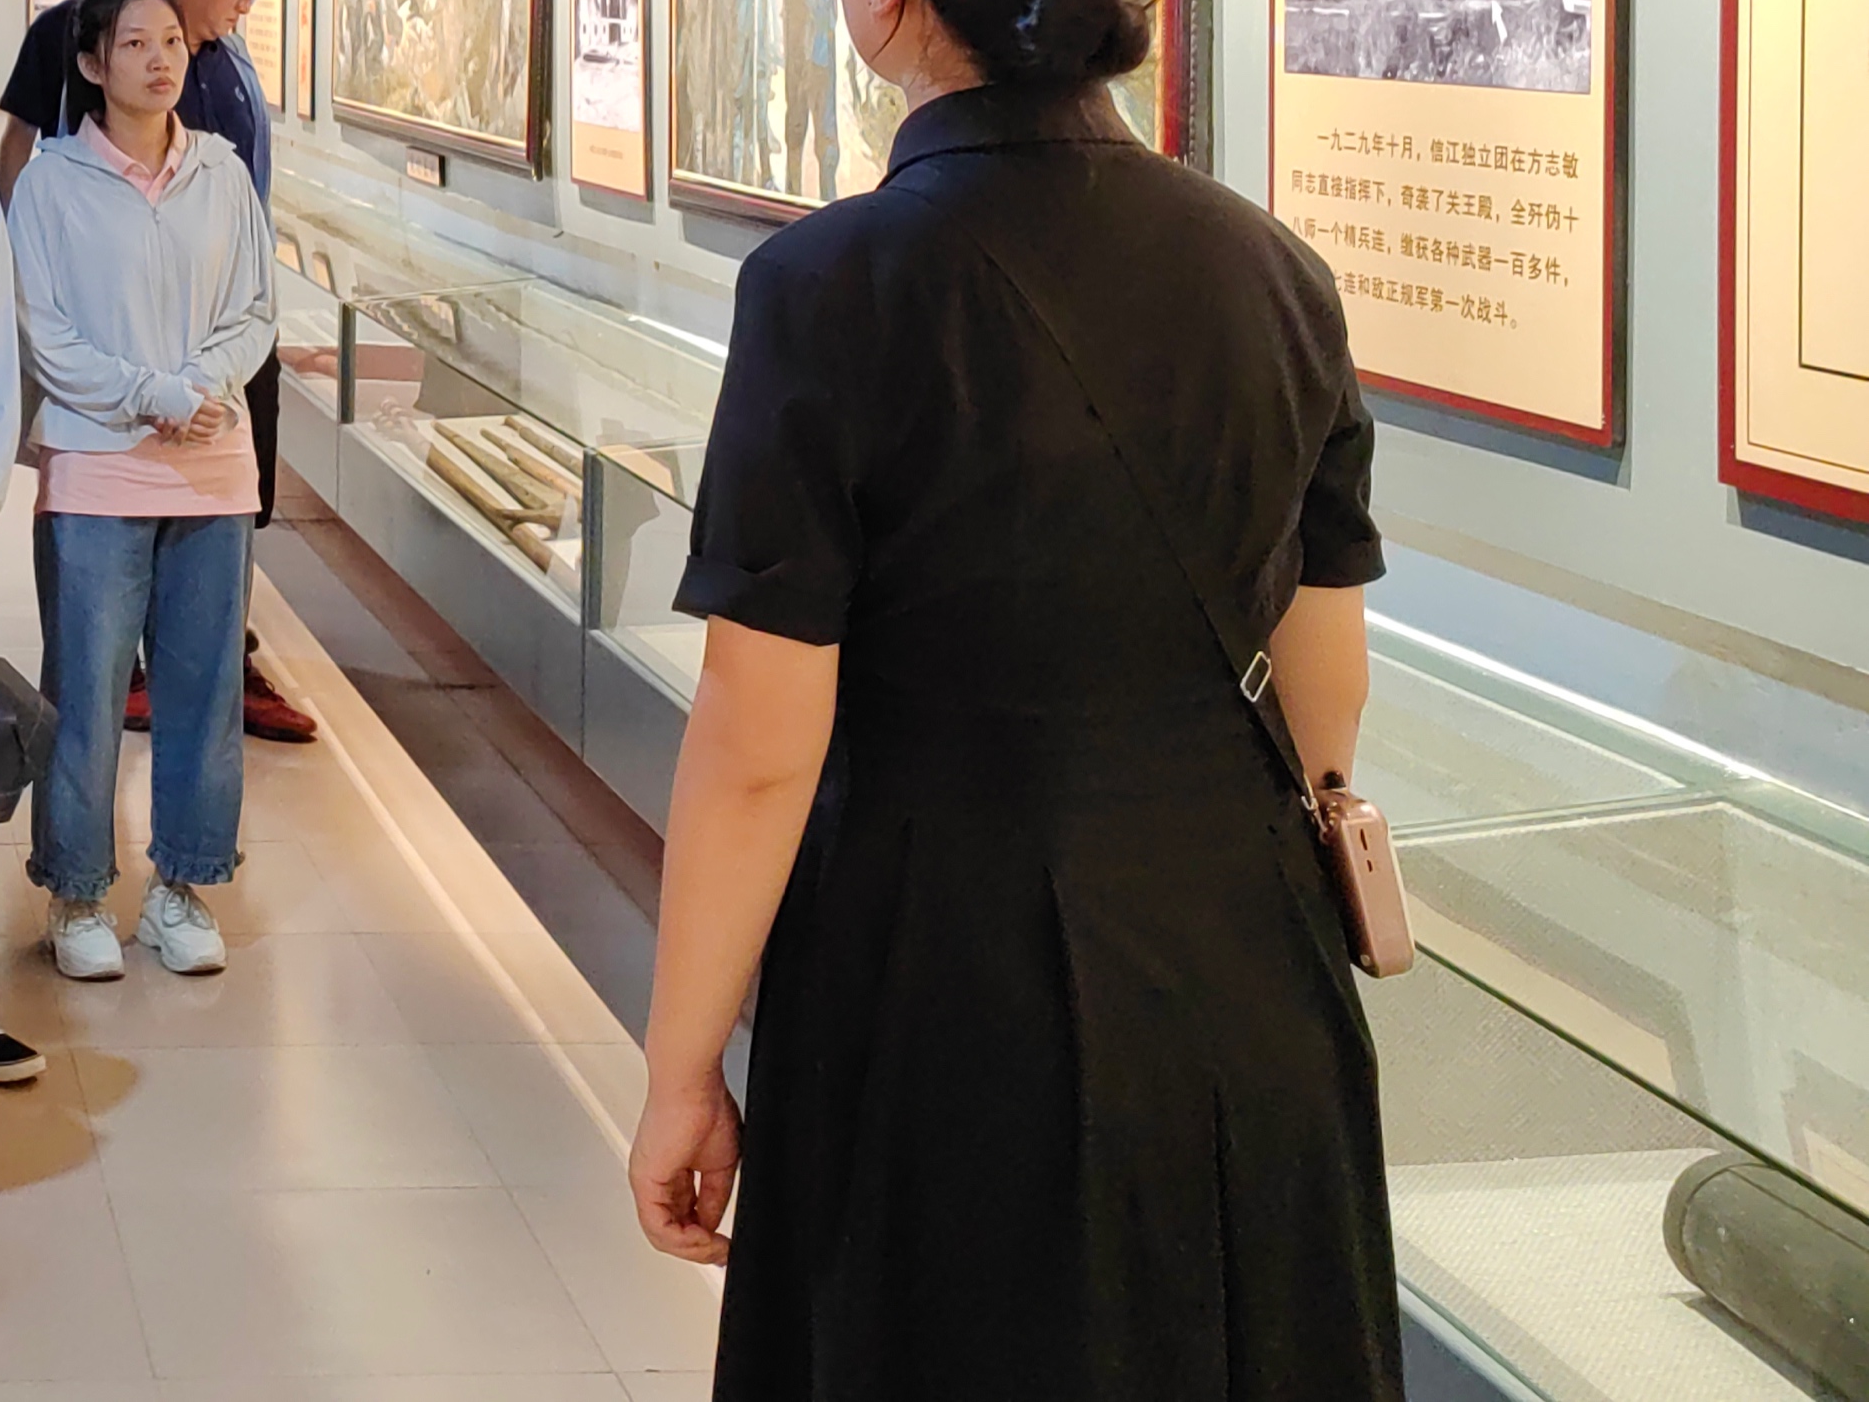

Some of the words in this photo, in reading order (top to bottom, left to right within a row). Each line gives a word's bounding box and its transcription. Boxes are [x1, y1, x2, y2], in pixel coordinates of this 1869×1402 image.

[1317, 128, 1579, 179] 一九二九年十月，信江独立团在方志敏
[1291, 170, 1580, 233] 同志直接指挥下，奇袭了关王殿，全歼伪十
